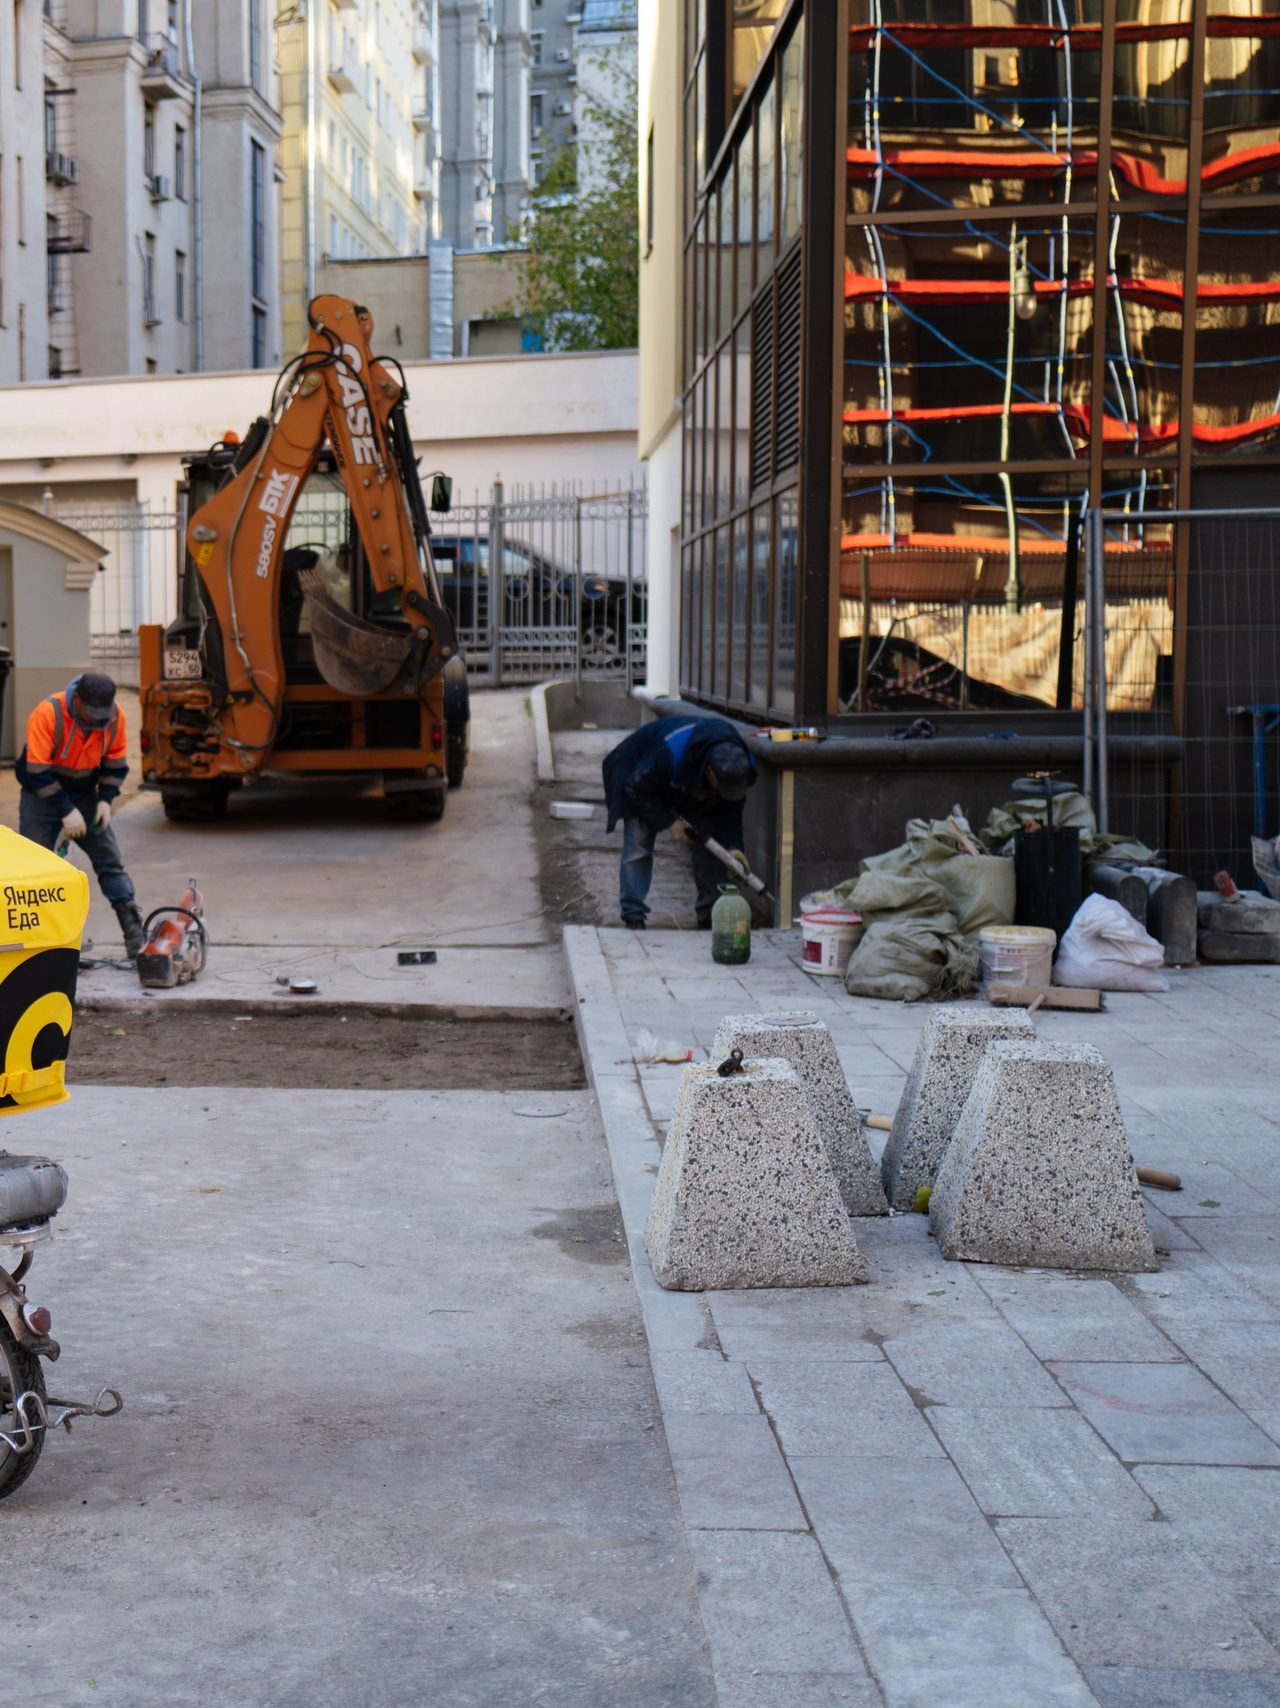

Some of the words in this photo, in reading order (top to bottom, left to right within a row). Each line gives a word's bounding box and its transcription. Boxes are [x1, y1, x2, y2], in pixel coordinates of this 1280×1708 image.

[333, 343, 378, 465] CASE
[259, 468, 291, 515] БТК
[256, 513, 277, 579] 580SV
[169, 652, 198, 664] 5294
[188, 664, 200, 674] 50
[3, 886, 66, 907] Яндекс
[7, 908, 40, 931] Еда
